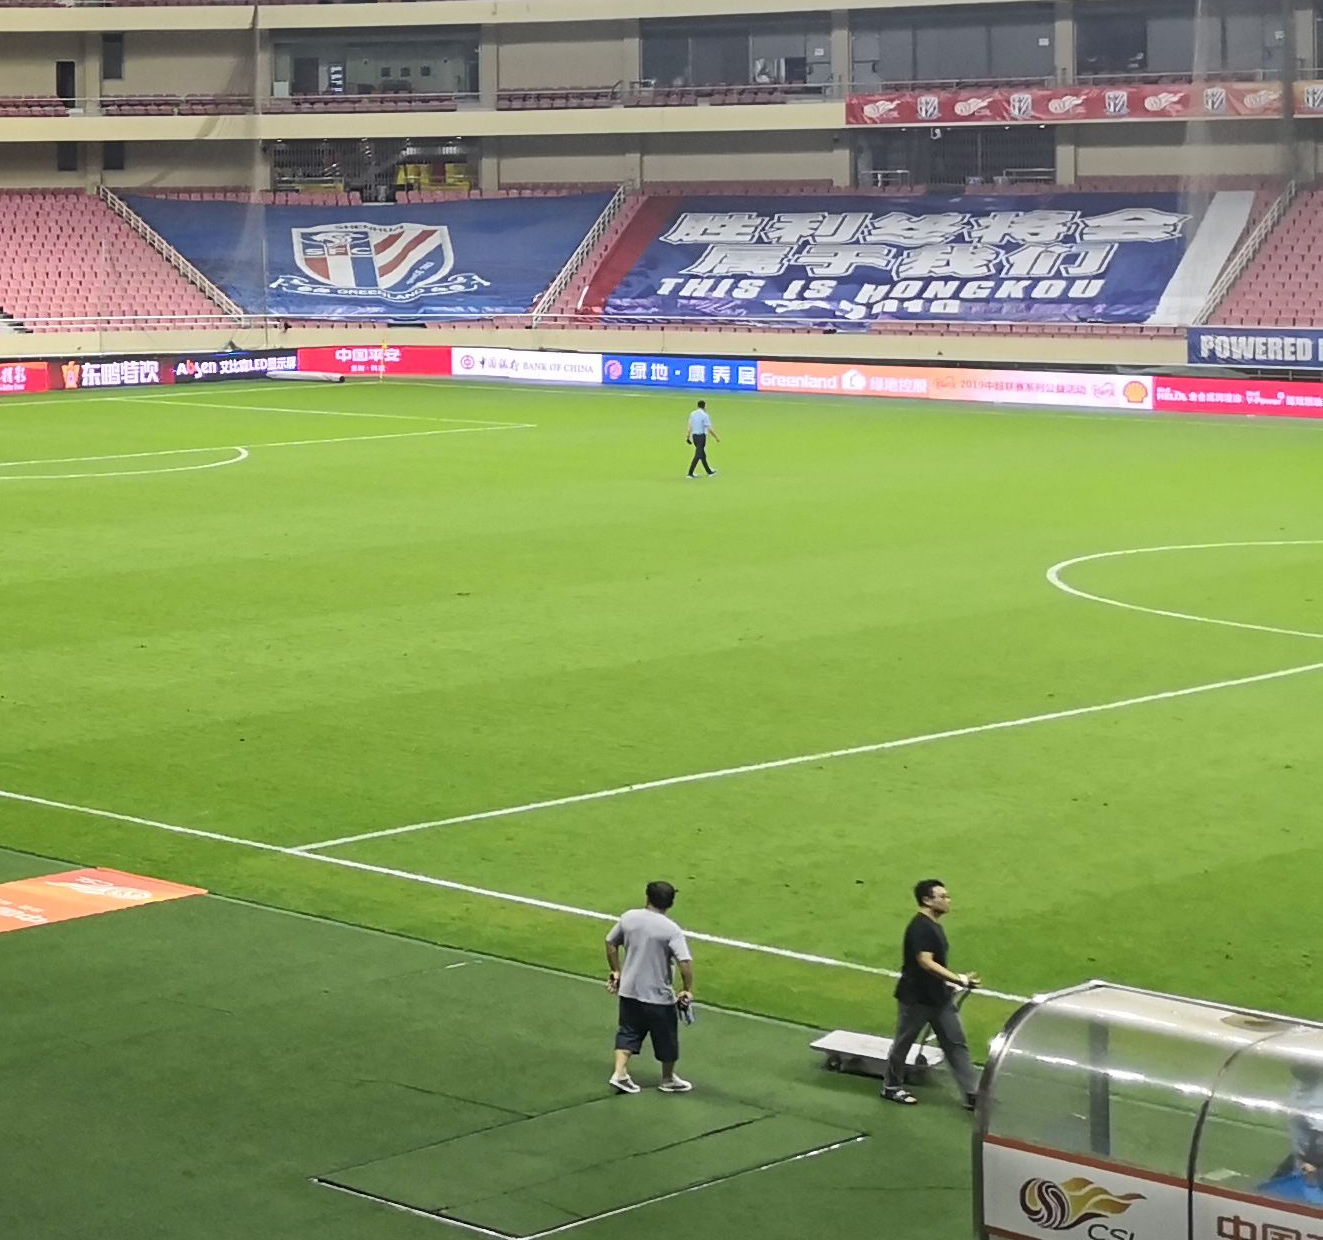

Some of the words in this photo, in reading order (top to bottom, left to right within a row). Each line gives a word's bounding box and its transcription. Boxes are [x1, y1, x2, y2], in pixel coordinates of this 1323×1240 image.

[657, 278, 765, 299] THIS
[783, 279, 837, 299] IS
[855, 274, 1106, 303] HONGKOU
[335, 348, 401, 362] 中国平安
[1200, 335, 1312, 361] POWERED
[81, 360, 159, 386] 东鹏特饮
[523, 362, 547, 371] BANK
[549, 363, 562, 372] OF
[564, 364, 594, 373] CHINA
[760, 372, 837, 390] Greenland
[1218, 1216, 1323, 1240] 中国
